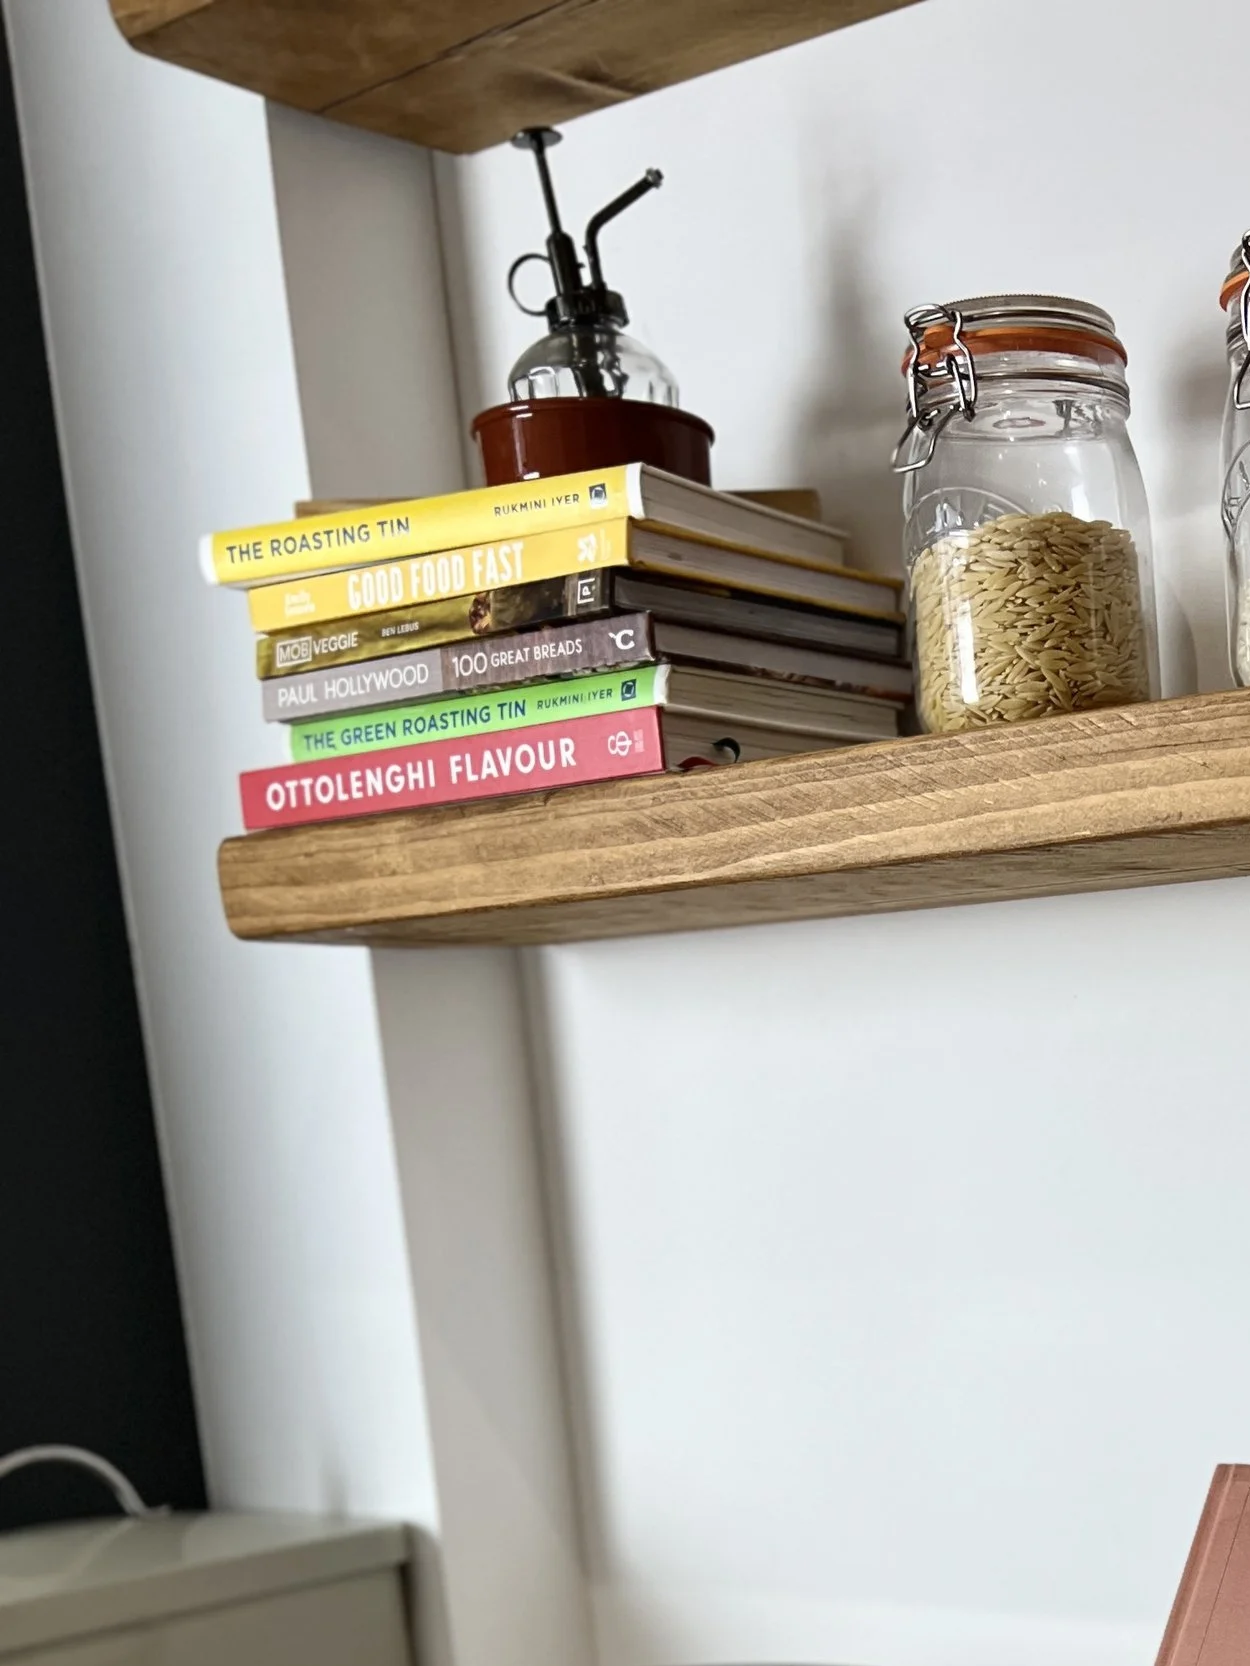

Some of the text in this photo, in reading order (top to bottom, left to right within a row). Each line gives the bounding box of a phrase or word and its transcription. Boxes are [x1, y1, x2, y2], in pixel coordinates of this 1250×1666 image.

[494, 493, 580, 516] RUKMINI IYER
[226, 516, 410, 563] THE ROASTING TIN
[347, 564, 404, 610] GOOD
[410, 552, 466, 599] FOOD
[472, 541, 524, 588] FAST
[278, 631, 359, 664] MOB VEGGIE
[381, 621, 420, 637] BEN LEBUS
[452, 638, 583, 678] 100 GREAT BREADS
[278, 663, 430, 708] PAUL HOLLYWOOD
[536, 688, 613, 710] RUKMINI IYER
[303, 699, 527, 751] THE GREEN ROASTING TIN
[265, 759, 436, 811] OTTOLENGHI
[450, 737, 577, 785] FLAVOUR
